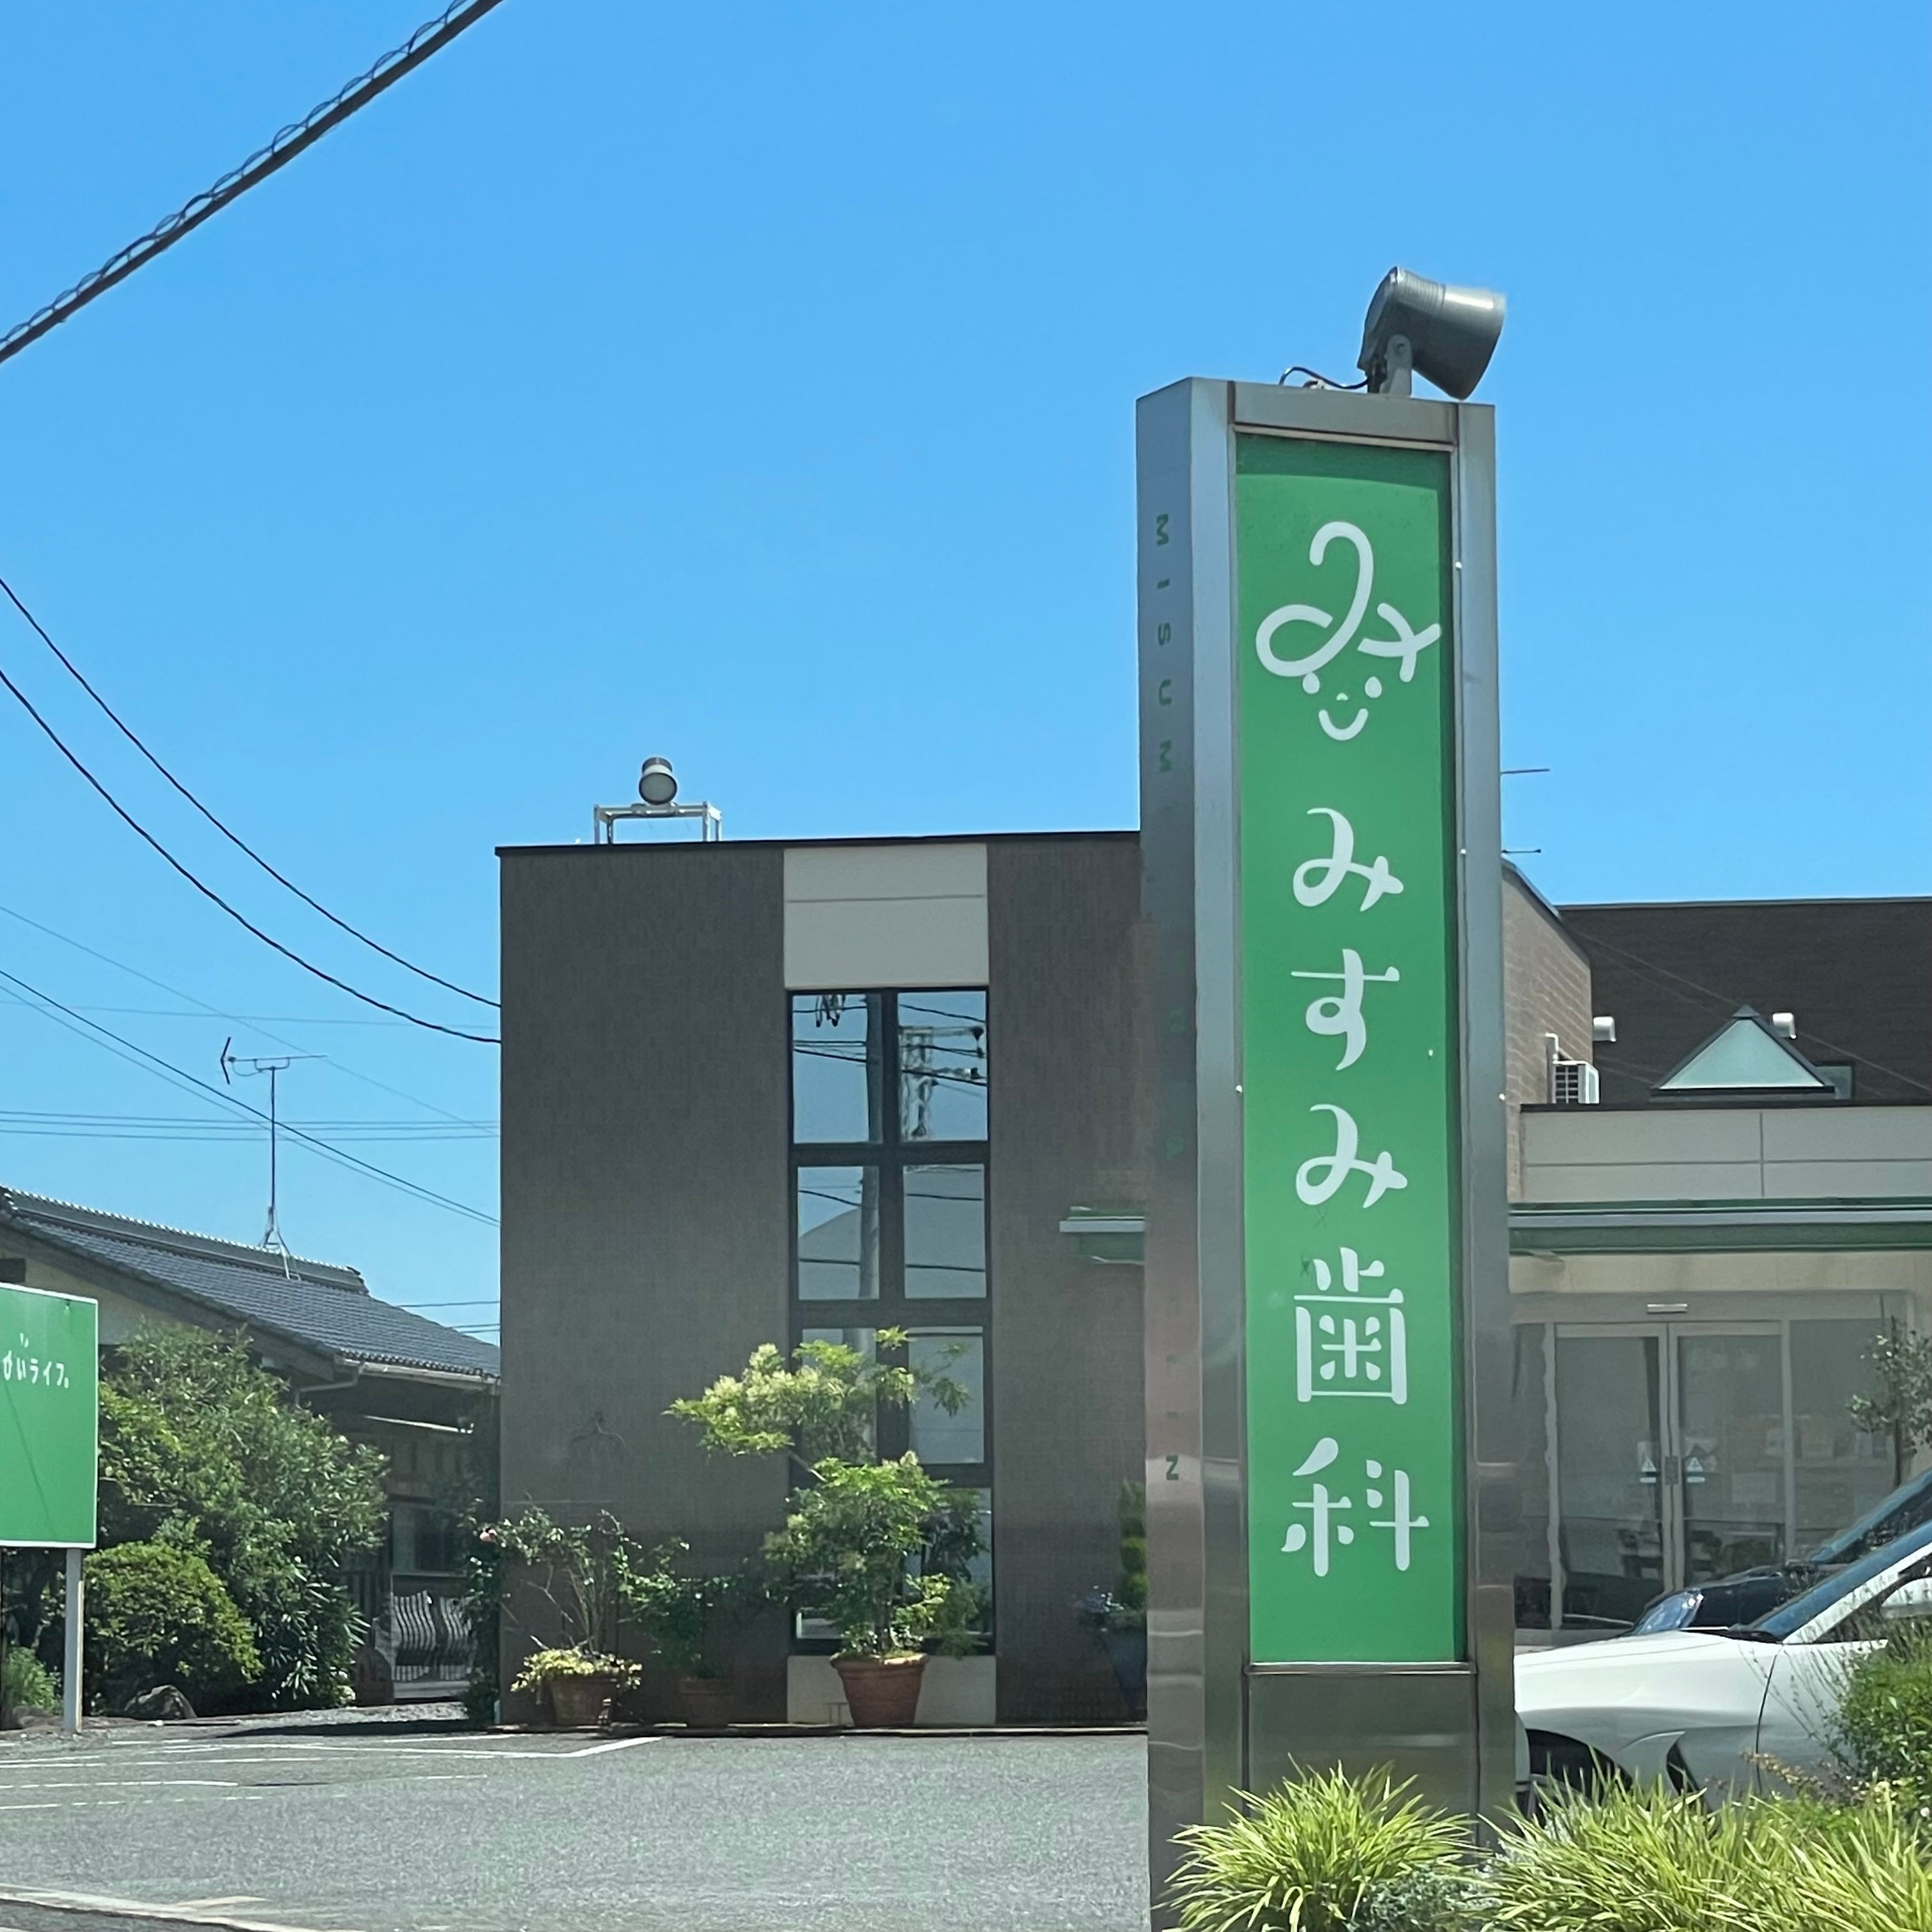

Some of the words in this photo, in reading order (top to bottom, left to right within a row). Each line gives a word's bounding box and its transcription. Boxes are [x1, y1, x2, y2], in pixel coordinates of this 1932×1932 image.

[1280, 807, 1430, 1577] みすみ歯科
